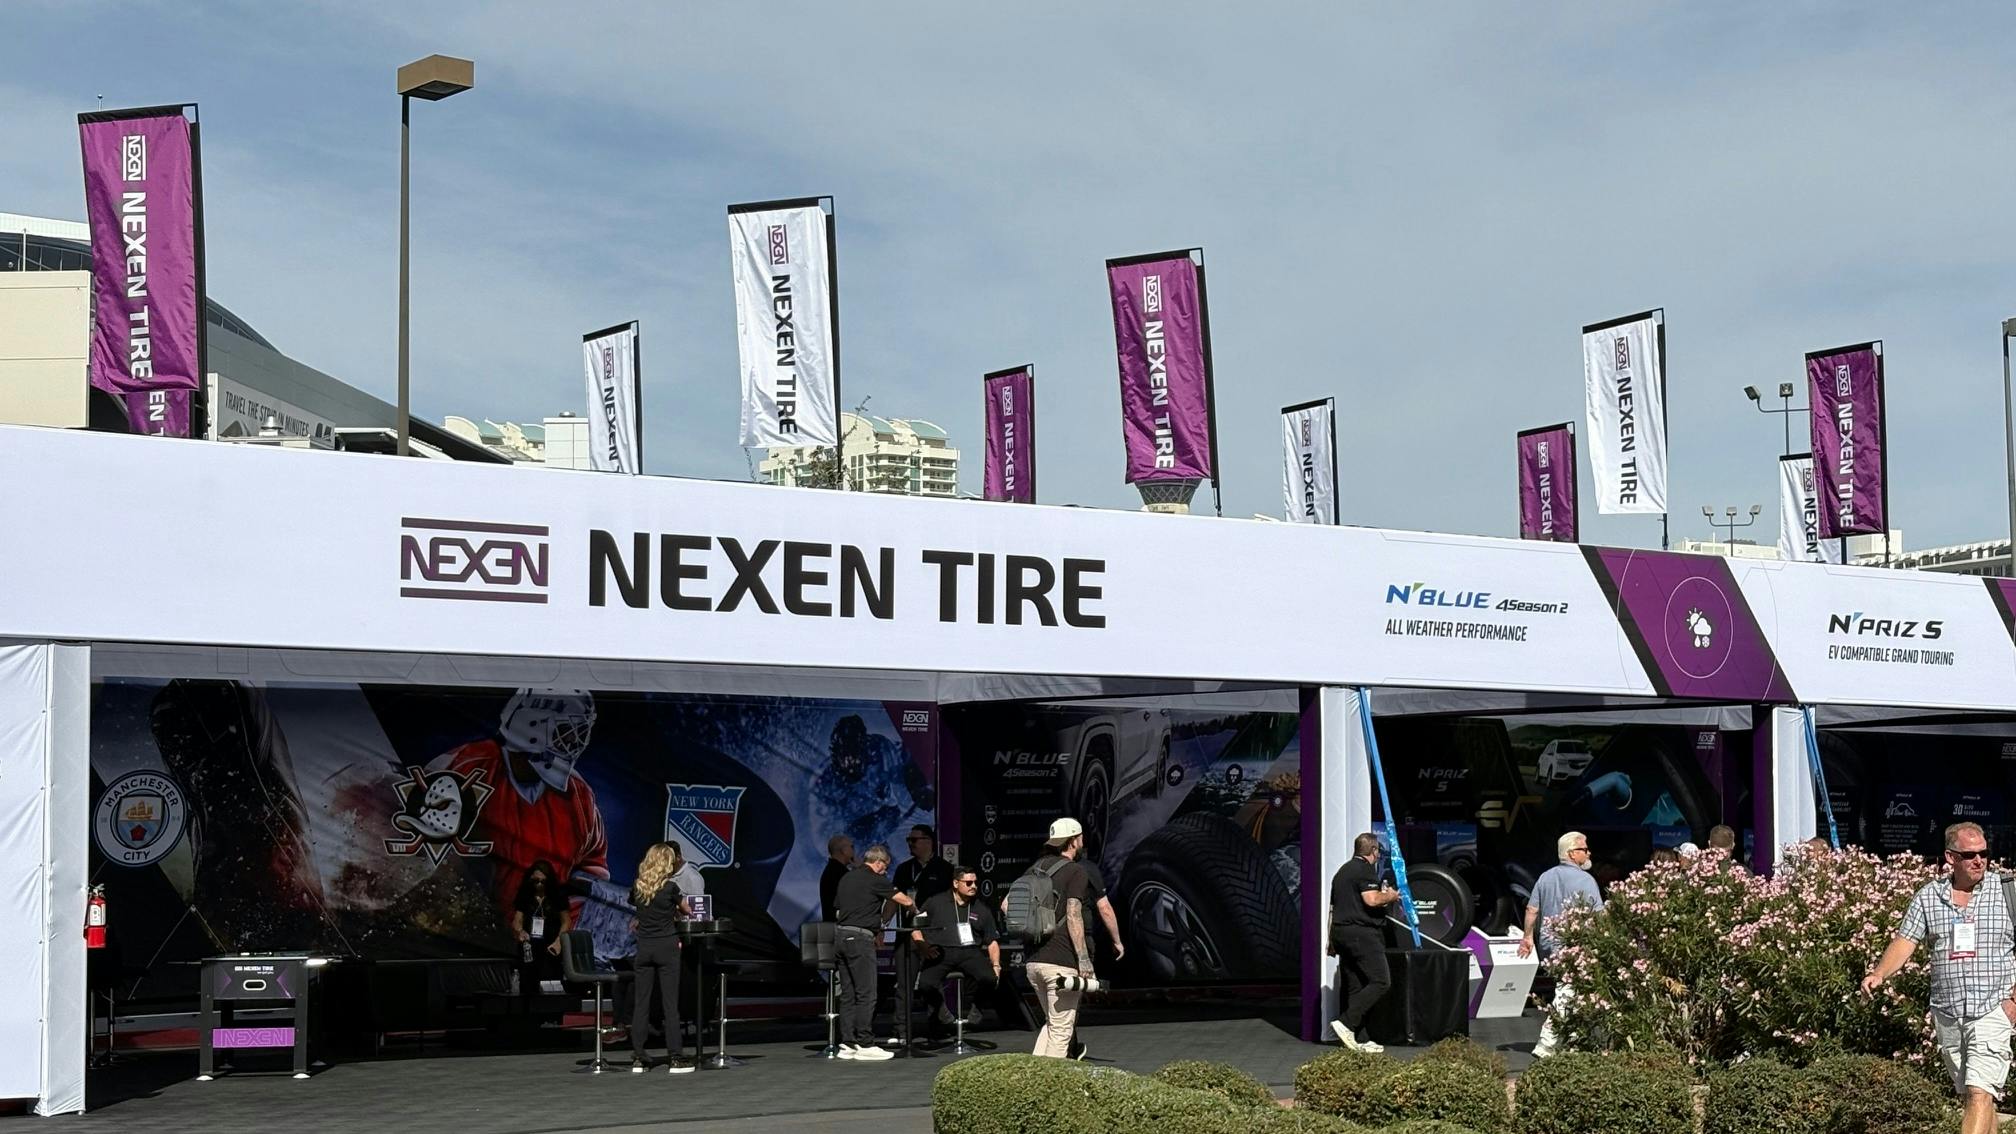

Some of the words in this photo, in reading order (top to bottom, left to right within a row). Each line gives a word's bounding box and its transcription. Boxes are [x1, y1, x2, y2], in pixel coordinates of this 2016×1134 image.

[127, 135, 142, 181] NEXEN
[122, 191, 148, 298] NEXEN
[771, 224, 786, 265] NEXEN
[1146, 275, 1159, 312] NEXEN
[129, 304, 153, 379] TIRE
[771, 274, 796, 366] NEXEN
[1145, 321, 1168, 406] NEXEN
[1616, 336, 1628, 370] NEXEN
[776, 374, 798, 435] TIRE
[1837, 364, 1849, 396] NEXEN
[225, 391, 246, 415] TRAVEL
[247, 400, 259, 420] THE
[285, 415, 310, 436] MINUTES
[604, 386, 619, 461] NEXEN
[1616, 376, 1635, 453] NEXEN
[1004, 422, 1015, 491] NEXEN
[1154, 412, 1175, 469] TIRE
[1838, 402, 1854, 475] NEXEN
[1303, 453, 1315, 517] NEXEN
[1539, 473, 1553, 535] NEXEN
[1620, 456, 1638, 505] TIRE
[1838, 478, 1855, 528] TIRE
[1804, 497, 1818, 554] NEXEN
[401, 534, 549, 588] NEXEN
[588, 529, 895, 621] NEXEN
[922, 549, 1106, 629] TIRE
[1385, 618, 1403, 635] ALL
[1406, 619, 1453, 638] WEATHER
[1455, 622, 1528, 642] PERFORMANCE
[1495, 598, 1557, 614] 4Season
[1559, 602, 1569, 614] 2
[1921, 620, 1944, 640] S
[1828, 645, 1840, 660] EV
[1840, 645, 1890, 663] COMPATIBLE
[1891, 648, 1919, 664] GRAND
[1920, 650, 1955, 666] TOURING
[105, 777, 179, 808] MANCHESTER
[672, 795, 700, 808] NEW
[703, 796, 735, 810] YORK
[123, 850, 151, 861] CITY
[680, 814, 730, 861] RANGERS
[221, 1030, 288, 1048] NEXEN
